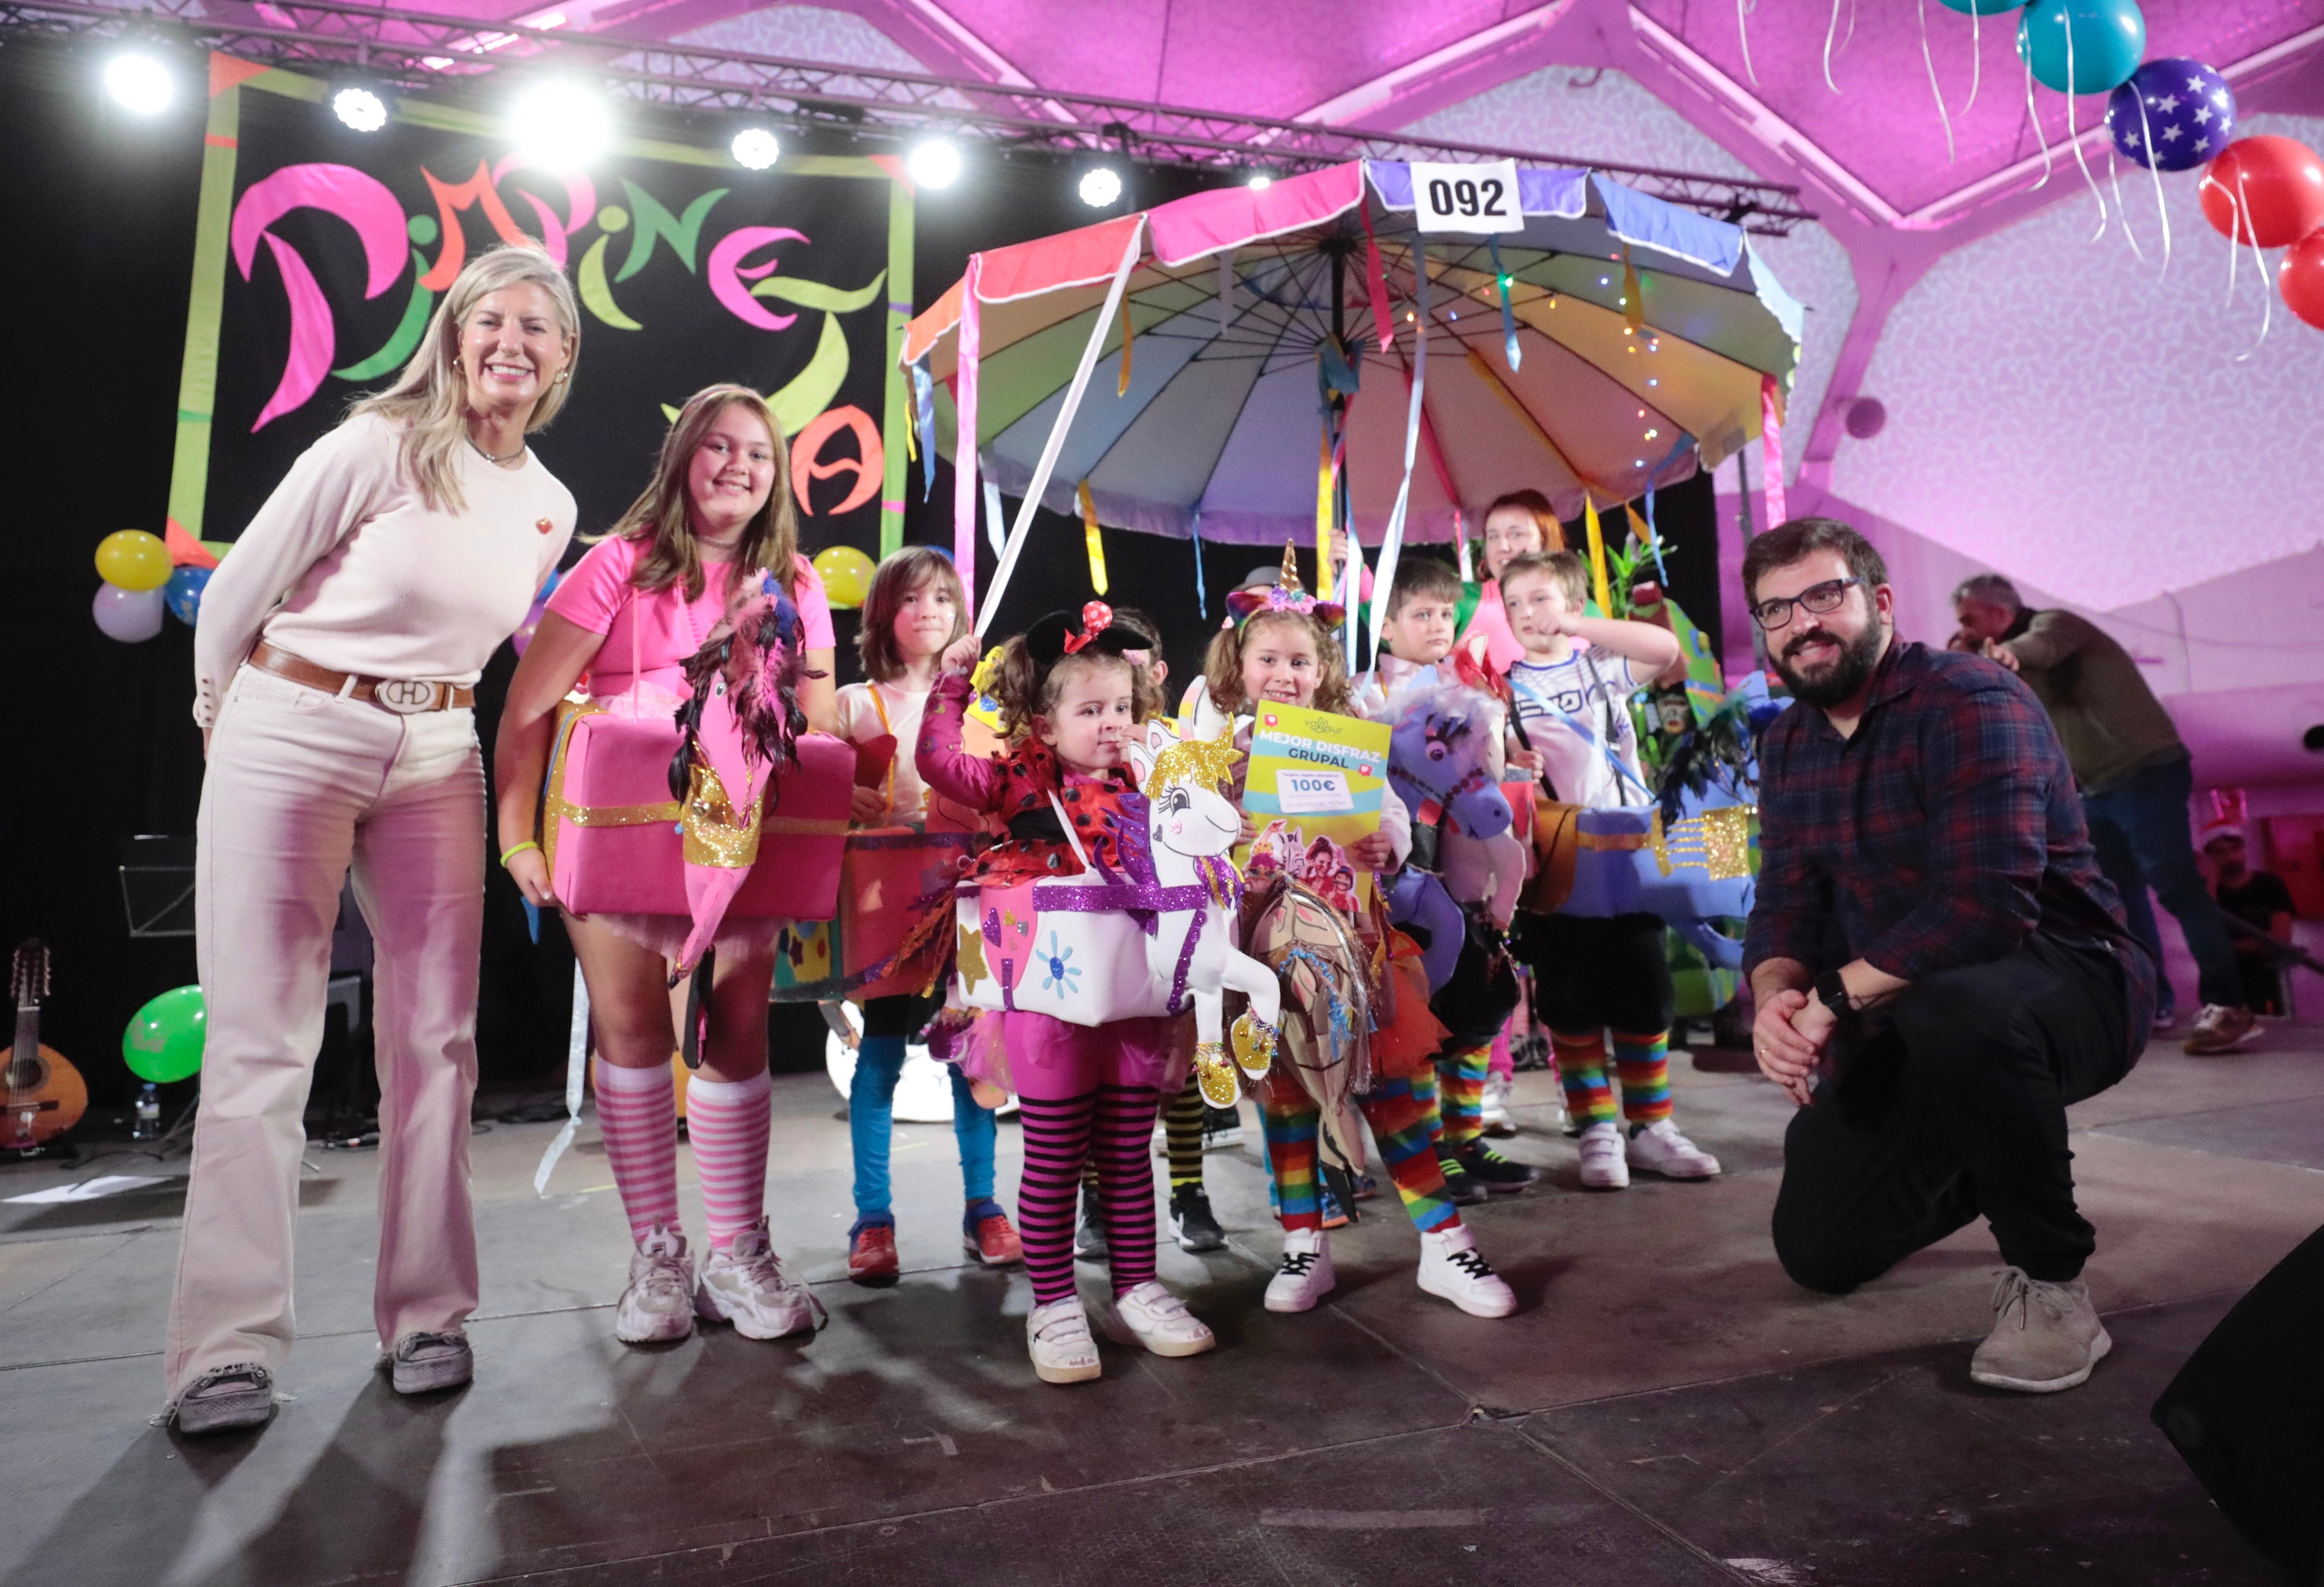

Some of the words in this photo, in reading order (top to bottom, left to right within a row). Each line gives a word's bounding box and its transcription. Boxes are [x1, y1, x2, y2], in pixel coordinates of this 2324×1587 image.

[1429, 179, 1507, 216] 092
[1305, 717, 1343, 734] vallsur
[1259, 730, 1312, 750] MEJOR
[1316, 741, 1381, 763] DISFRAZ
[1289, 748, 1349, 768] GRUPAL
[1291, 779, 1335, 791] 100€
